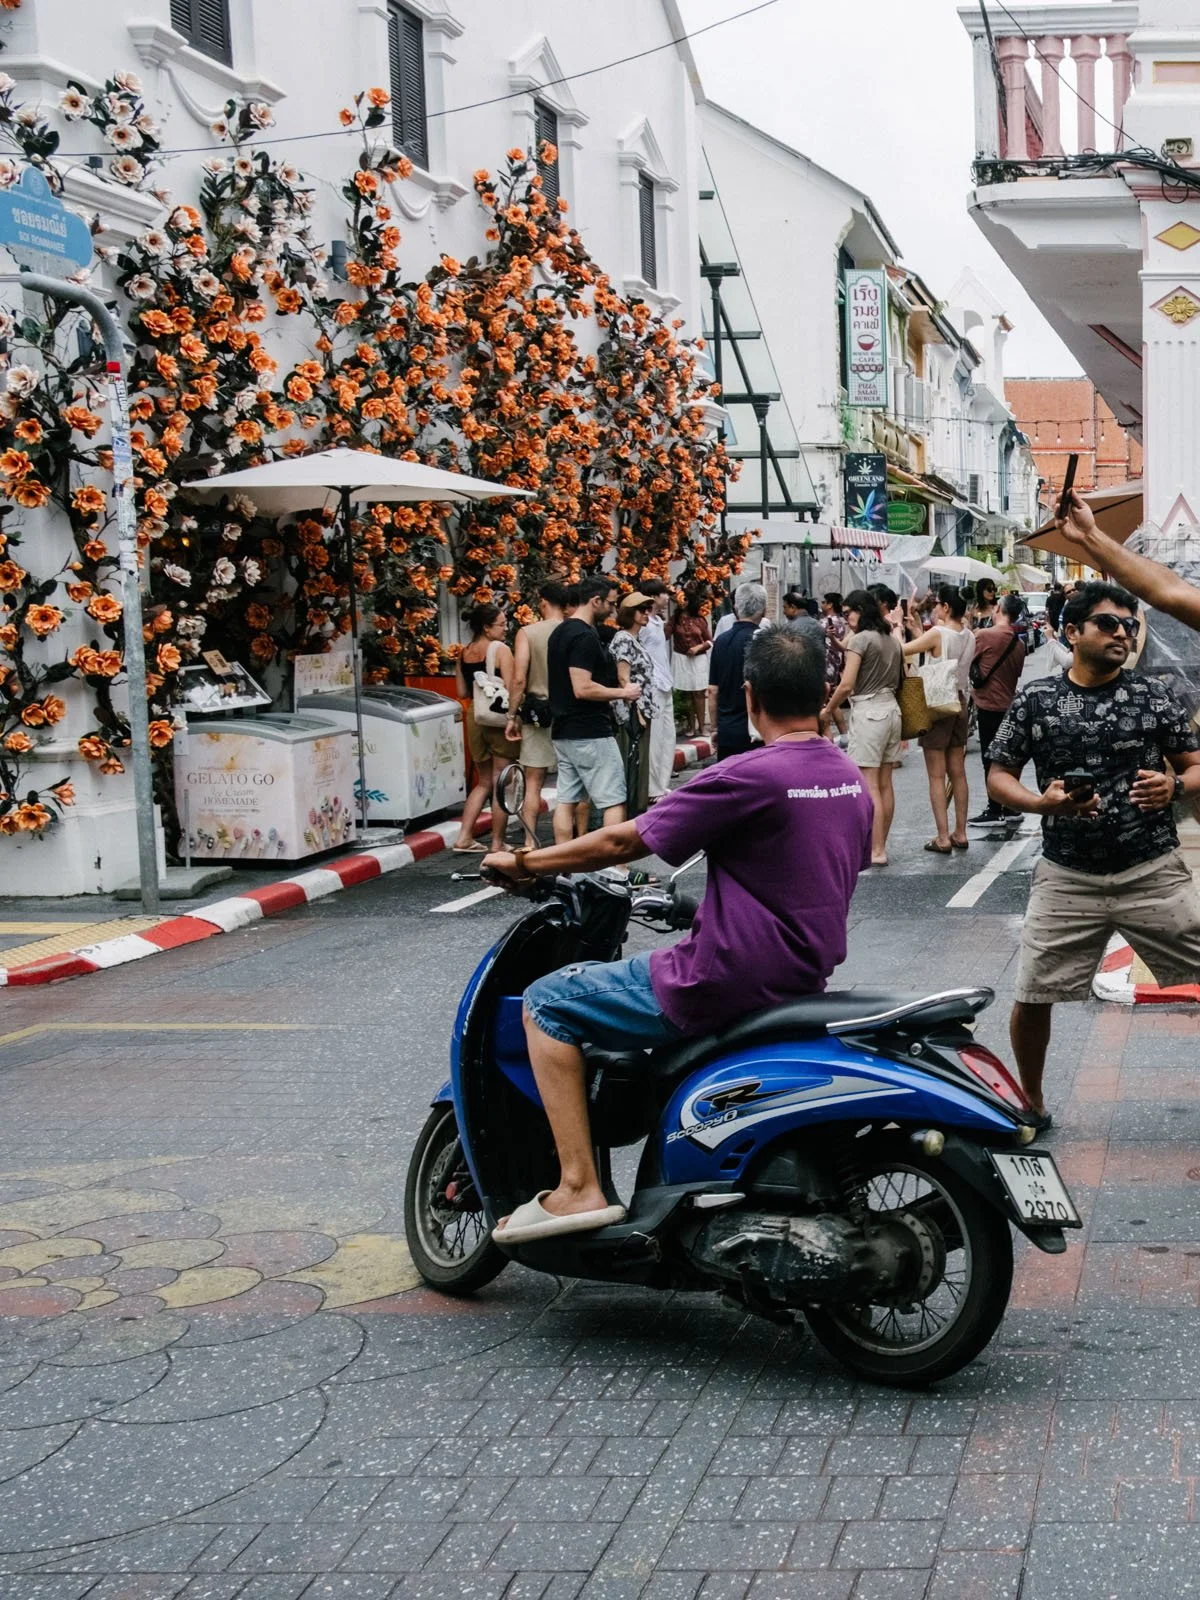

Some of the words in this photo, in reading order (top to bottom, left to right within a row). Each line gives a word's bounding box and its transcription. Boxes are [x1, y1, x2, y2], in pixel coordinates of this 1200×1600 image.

[187, 772, 248, 785] GELATO
[252, 773, 275, 786] GO
[203, 796, 259, 806] HOMEMADE
[1024, 1199, 1069, 1220] 2970
